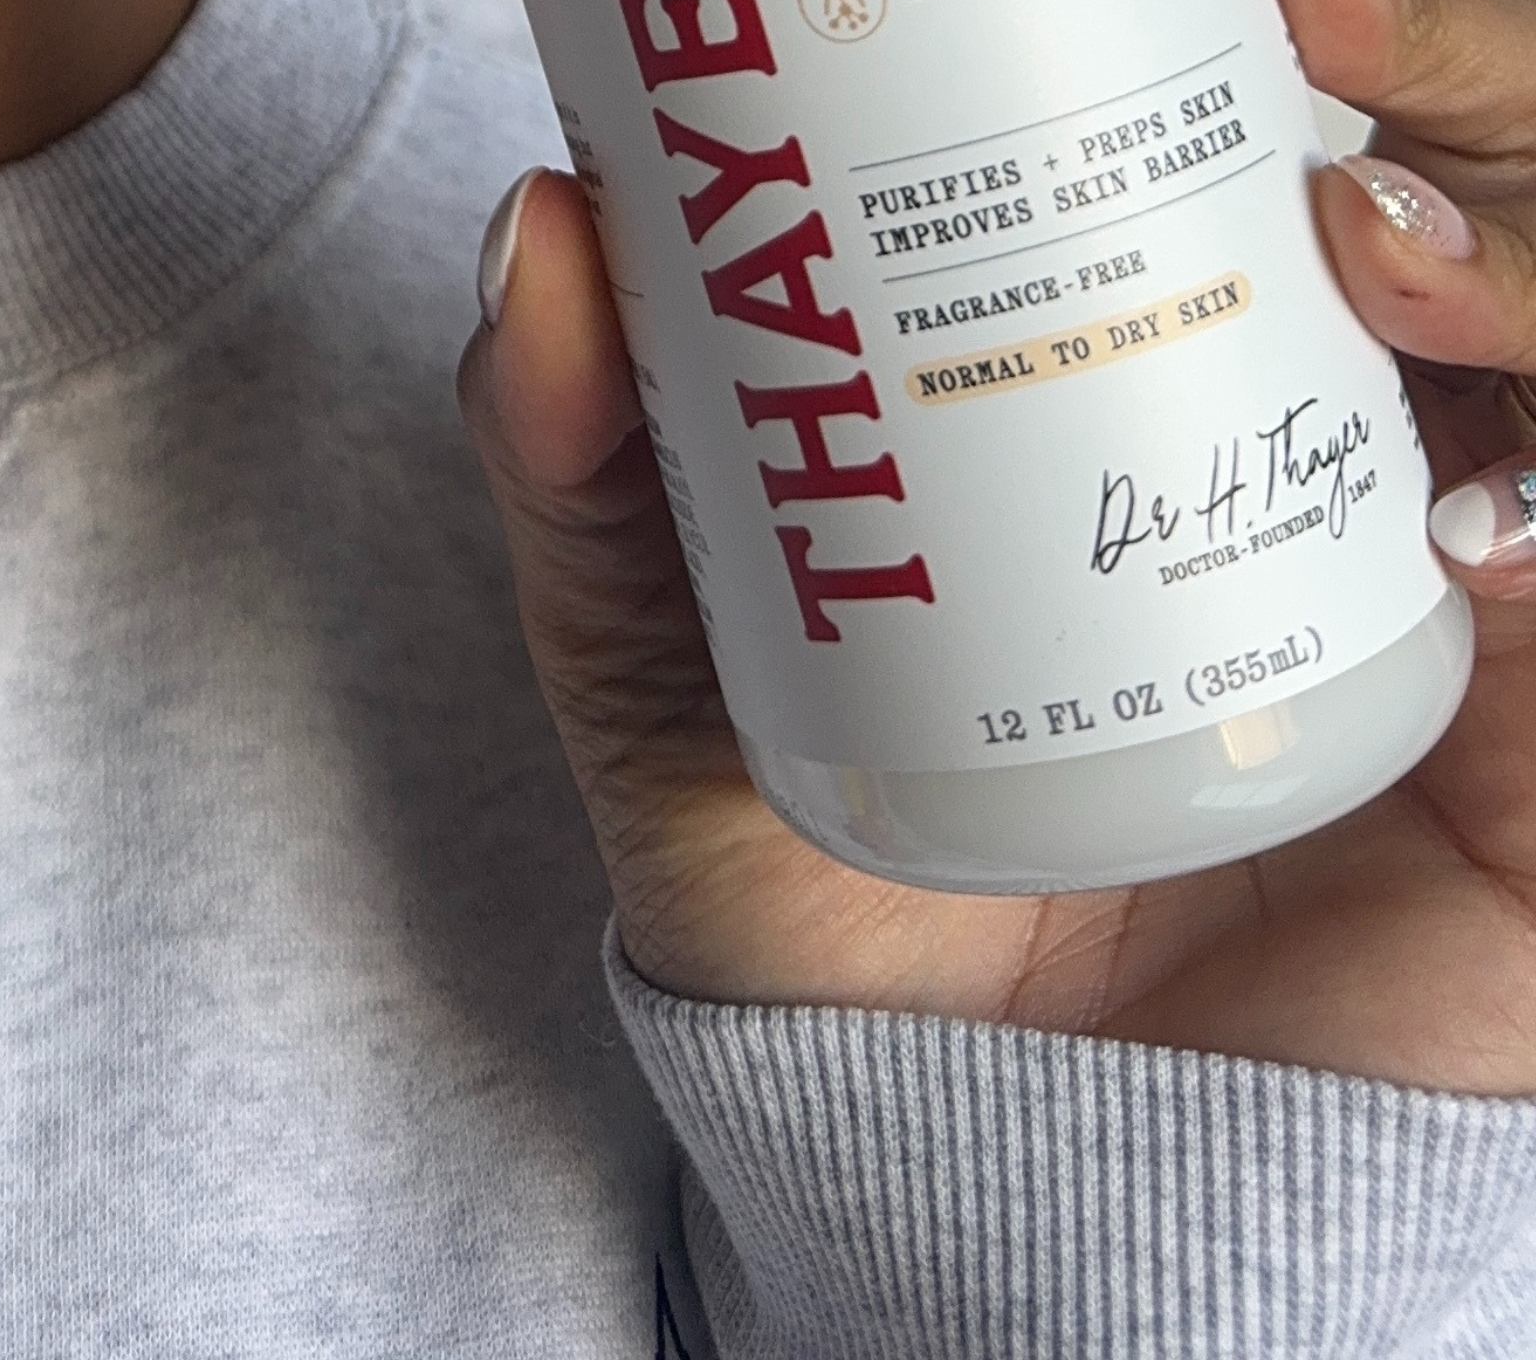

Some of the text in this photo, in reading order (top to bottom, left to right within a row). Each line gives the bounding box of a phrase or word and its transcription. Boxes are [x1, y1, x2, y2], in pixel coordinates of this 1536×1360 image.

[858, 81, 1234, 219] PURIFIES + PREPS SKIN
[869, 119, 1246, 257] IMPROVES SKIN BARRIER
[894, 250, 1146, 335] FRAGRANCE-FREE
[916, 281, 1239, 398] NORMAL TO DRY SKIN
[1158, 469, 1378, 585] DOCTOR-FOUNDED 1847
[1256, 397, 1369, 539] Thayer
[977, 626, 1322, 744] 12 FL OZ (355mL)
